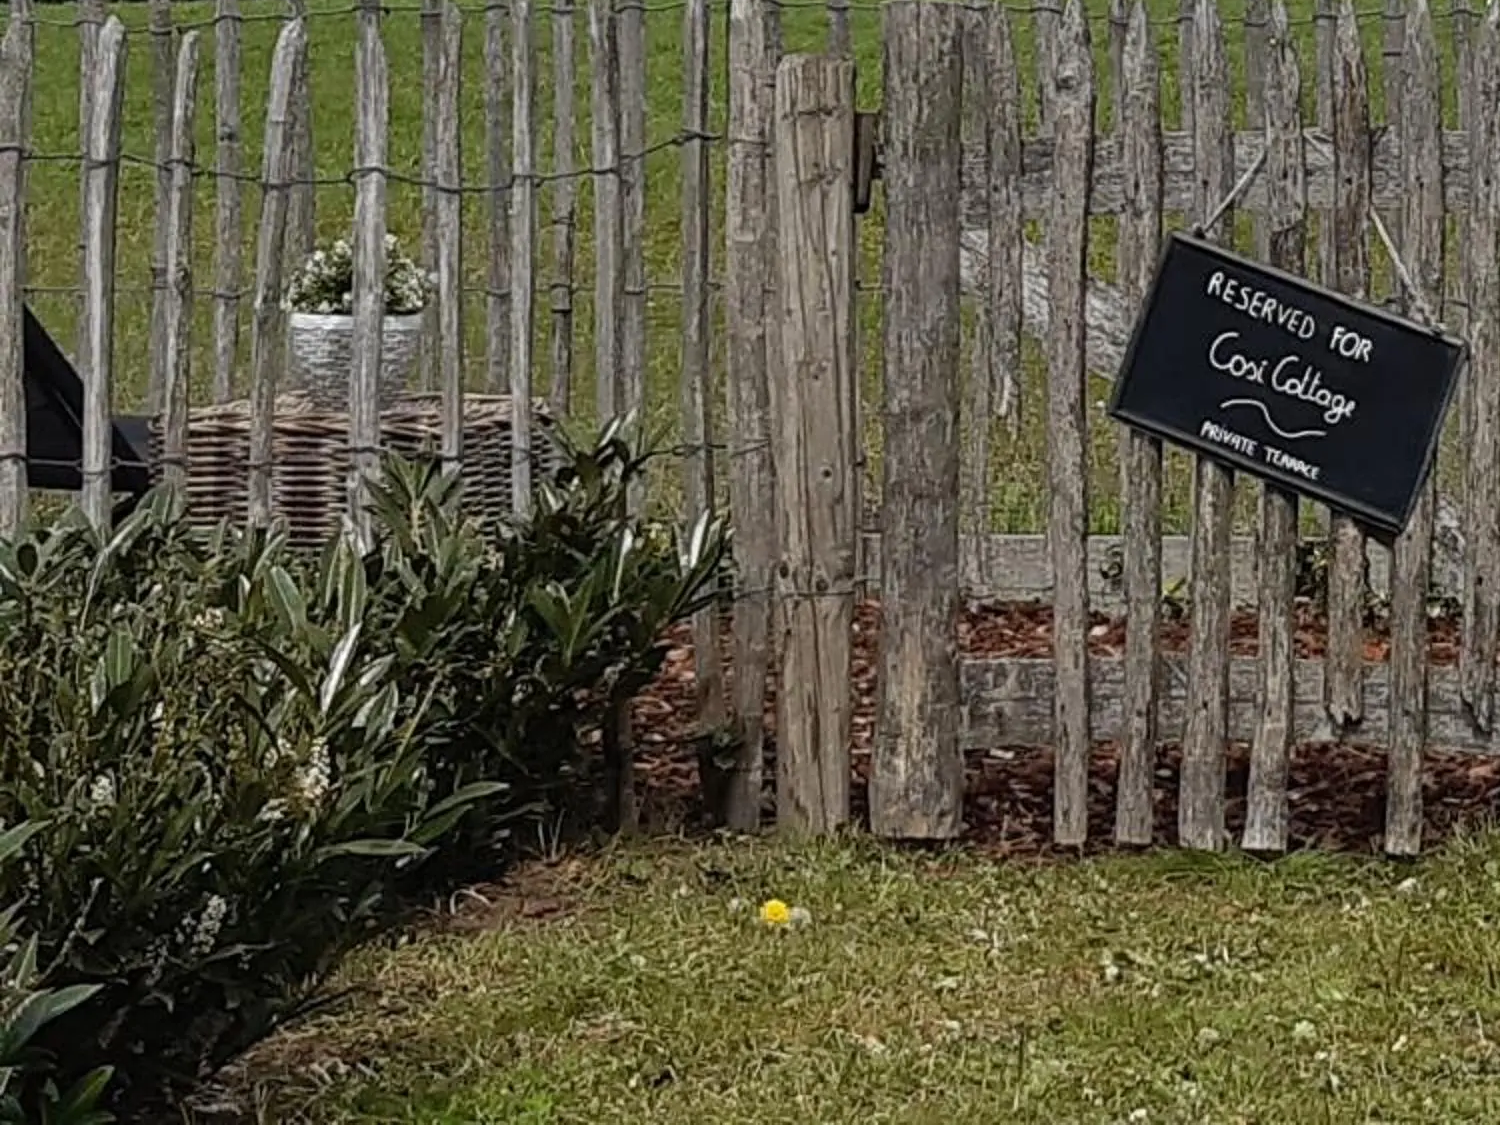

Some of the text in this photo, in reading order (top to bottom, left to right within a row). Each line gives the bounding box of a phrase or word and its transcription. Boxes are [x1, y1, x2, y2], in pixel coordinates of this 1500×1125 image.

[1207, 272, 1373, 362] RESERVED FOR
[1209, 332, 1356, 423] Cosi Cottage
[1201, 421, 1320, 480] PRIVATE TERRACE
